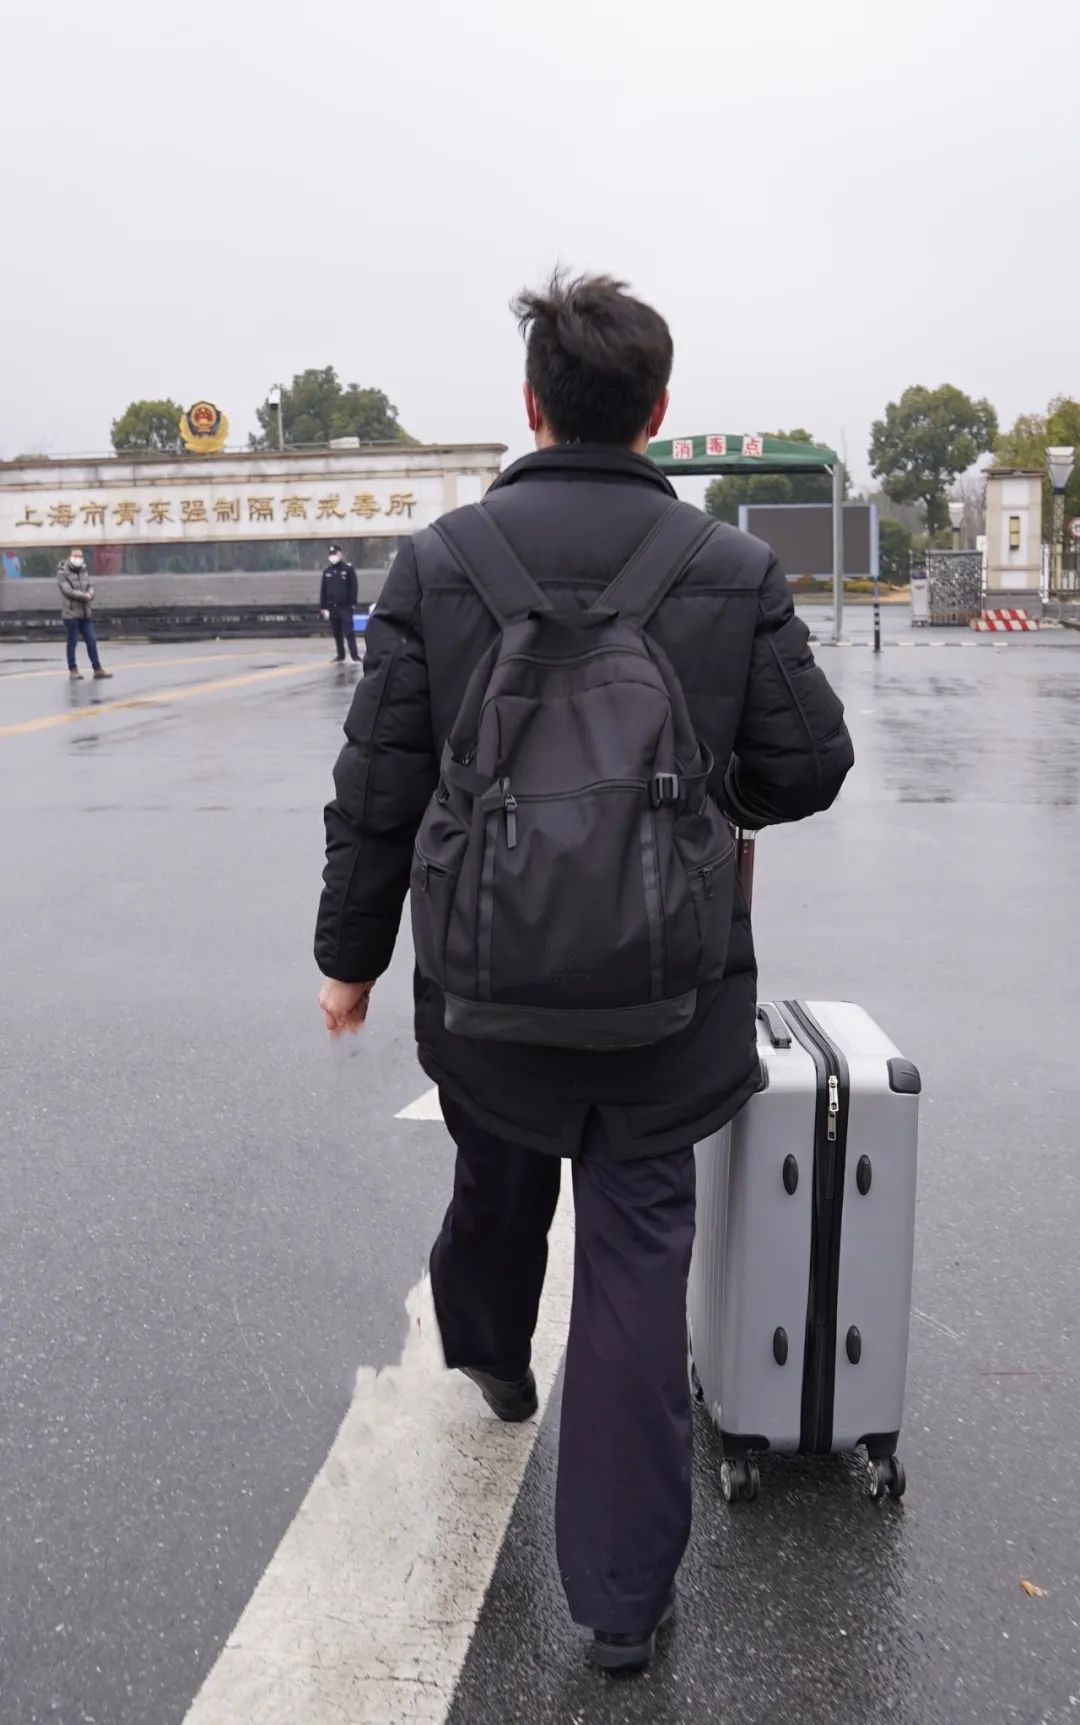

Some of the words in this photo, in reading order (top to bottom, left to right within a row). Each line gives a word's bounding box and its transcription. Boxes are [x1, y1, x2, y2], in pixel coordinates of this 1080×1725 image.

[673, 436, 761, 458] 消毒点
[15, 492, 417, 528] 上海市青东强制隔离戒毒所
